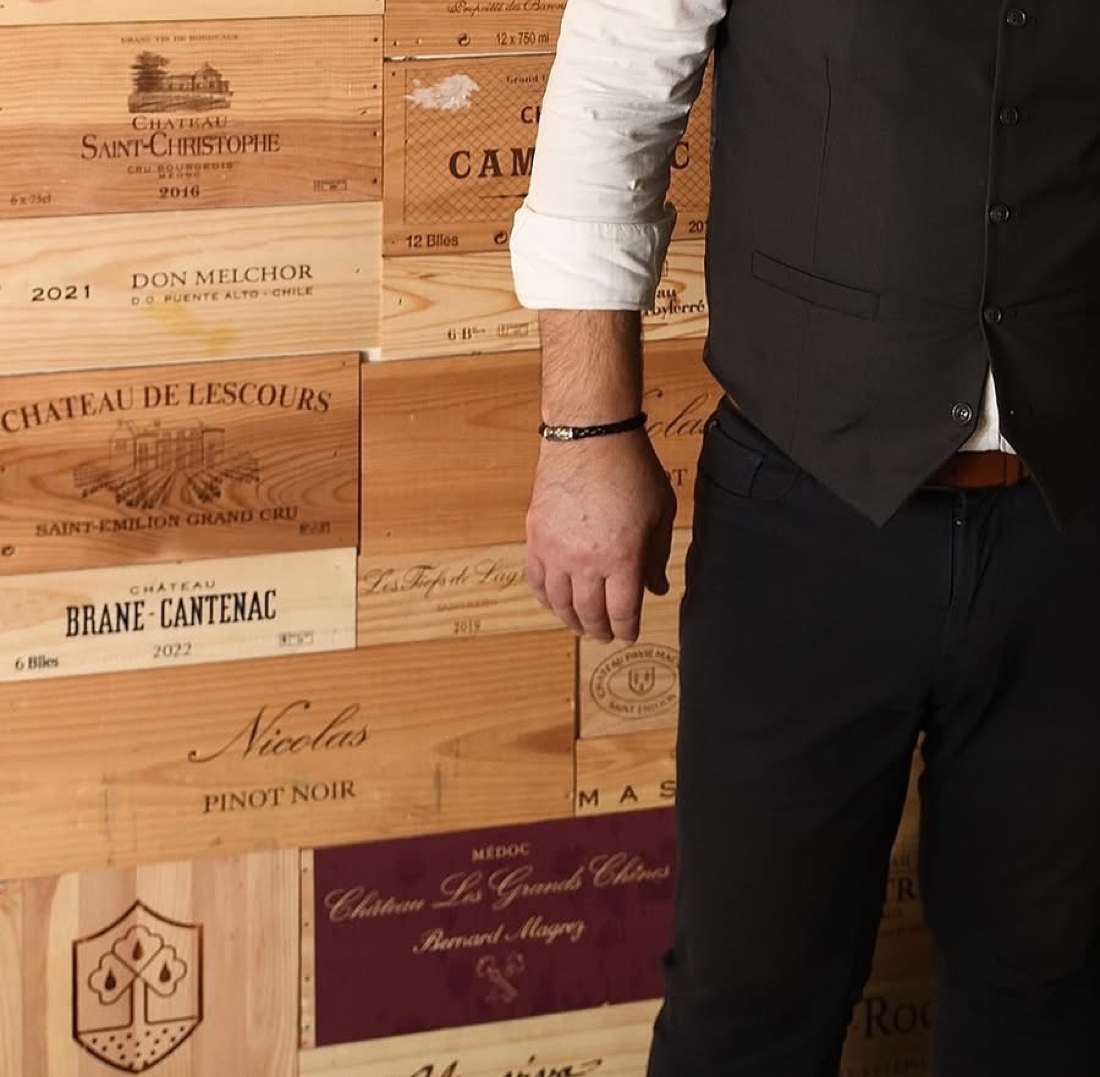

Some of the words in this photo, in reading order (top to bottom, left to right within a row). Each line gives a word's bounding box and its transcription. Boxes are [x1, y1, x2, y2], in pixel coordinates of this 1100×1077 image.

[158, 184, 201, 200] 2016
[131, 270, 188, 290] DON
[194, 263, 314, 287] MELCHOR
[31, 284, 92, 302] 2021
[164, 289, 220, 303] PUENTE
[224, 288, 260, 300] ALTO
[272, 286, 314, 299] CHILE
[1, 388, 134, 434] CHATEAU
[144, 385, 180, 409] DE
[189, 381, 332, 414] LESCOURS
[186, 509, 255, 527] GRAND
[259, 505, 299, 523] CRU
[153, 642, 193, 660] 2022
[187, 698, 371, 764] Nicolas
[203, 786, 285, 814] PINOT
[291, 778, 358, 804] NOIR
[472, 842, 531, 862] MÉDOC
[411, 924, 502, 956] Bernard
